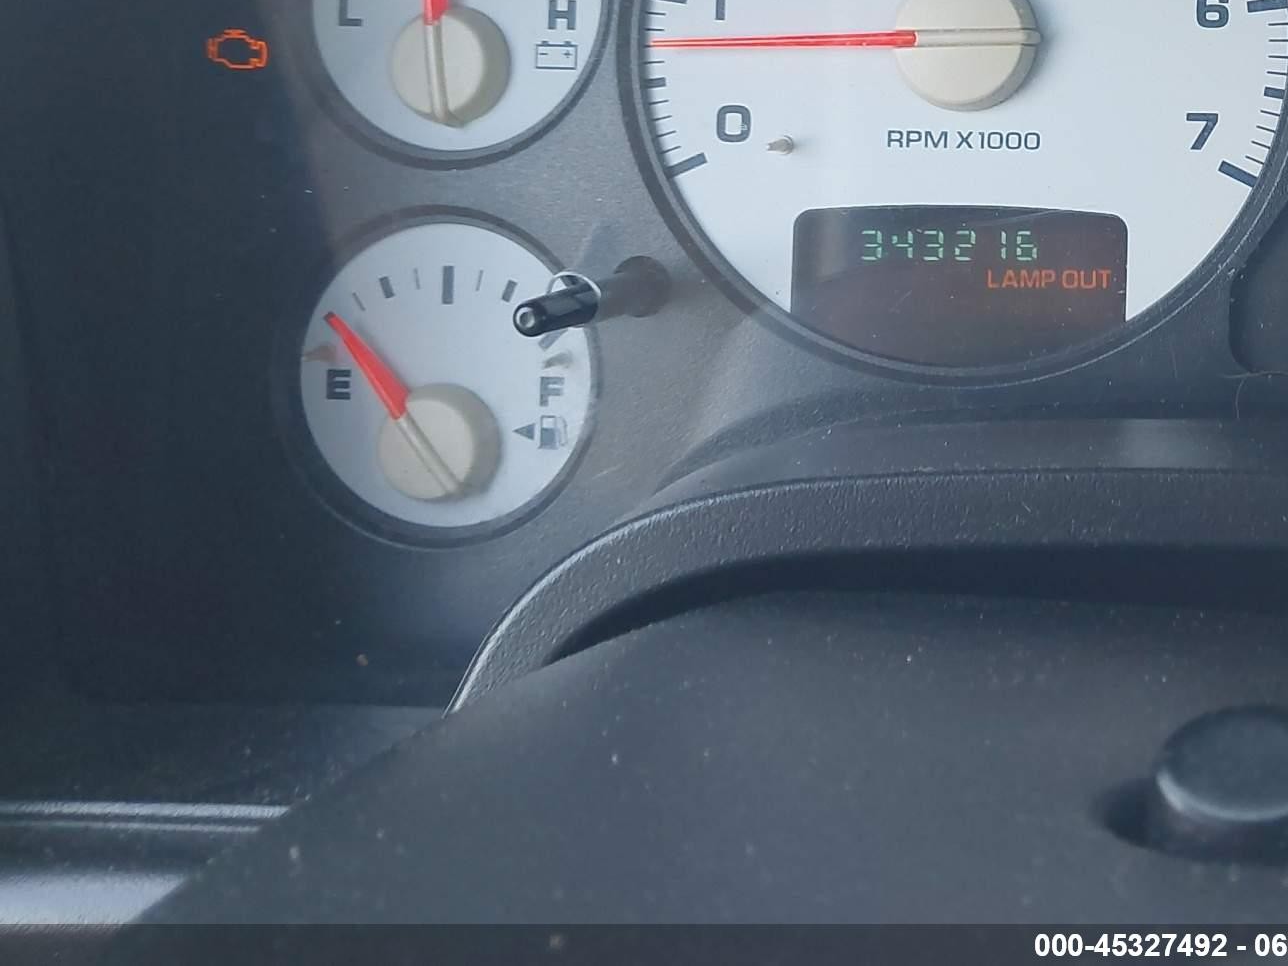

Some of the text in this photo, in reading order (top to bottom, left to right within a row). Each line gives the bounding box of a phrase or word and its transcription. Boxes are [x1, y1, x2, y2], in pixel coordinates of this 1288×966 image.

[547, 0, 576, 29] H
[716, 105, 751, 142] 0
[1186, 113, 1218, 150] 7
[888, 131, 948, 149] RPM
[861, 230, 1037, 261] 343216
[987, 270, 1111, 289] LAMP OUT
[326, 369, 351, 399] E
[539, 376, 564, 406] F
